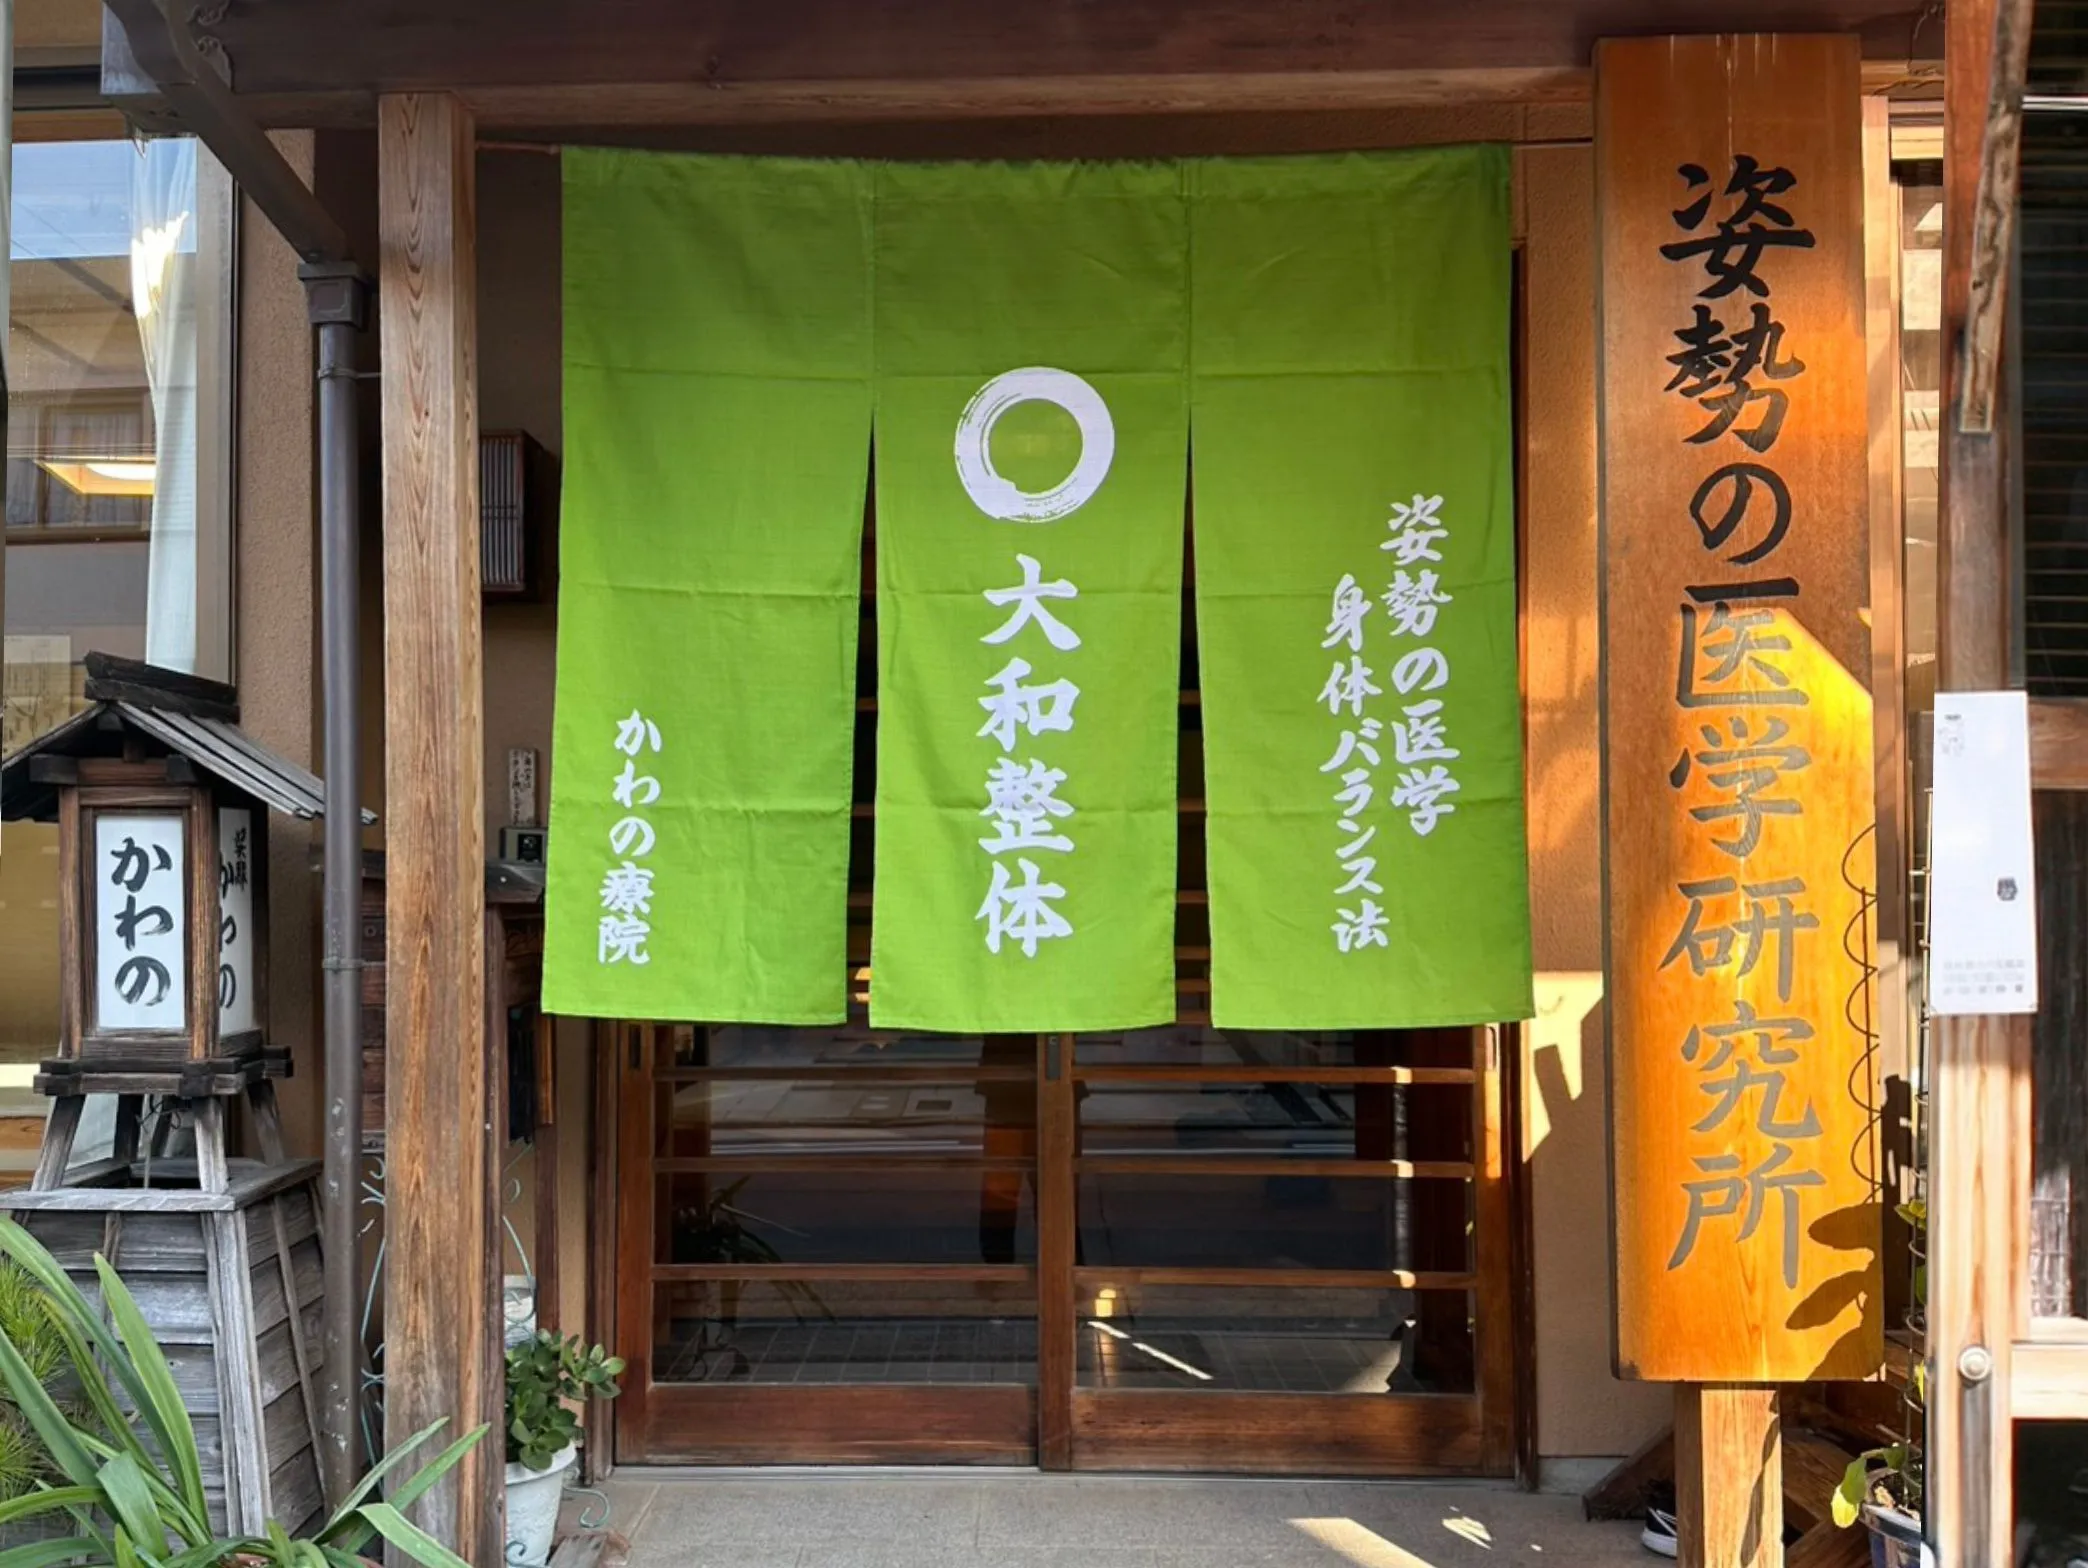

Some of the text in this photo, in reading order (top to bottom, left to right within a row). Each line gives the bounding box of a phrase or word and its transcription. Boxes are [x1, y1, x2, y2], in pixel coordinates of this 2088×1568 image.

[598, 708, 663, 966] かわの療院
[976, 553, 1083, 959] 大和整体
[1317, 573, 1391, 954] 身体バランス法
[1380, 493, 1461, 837] 姿勢の医学
[1658, 153, 1826, 1290] 姿勢の医学研究所
[110, 836, 174, 1007] かわの
